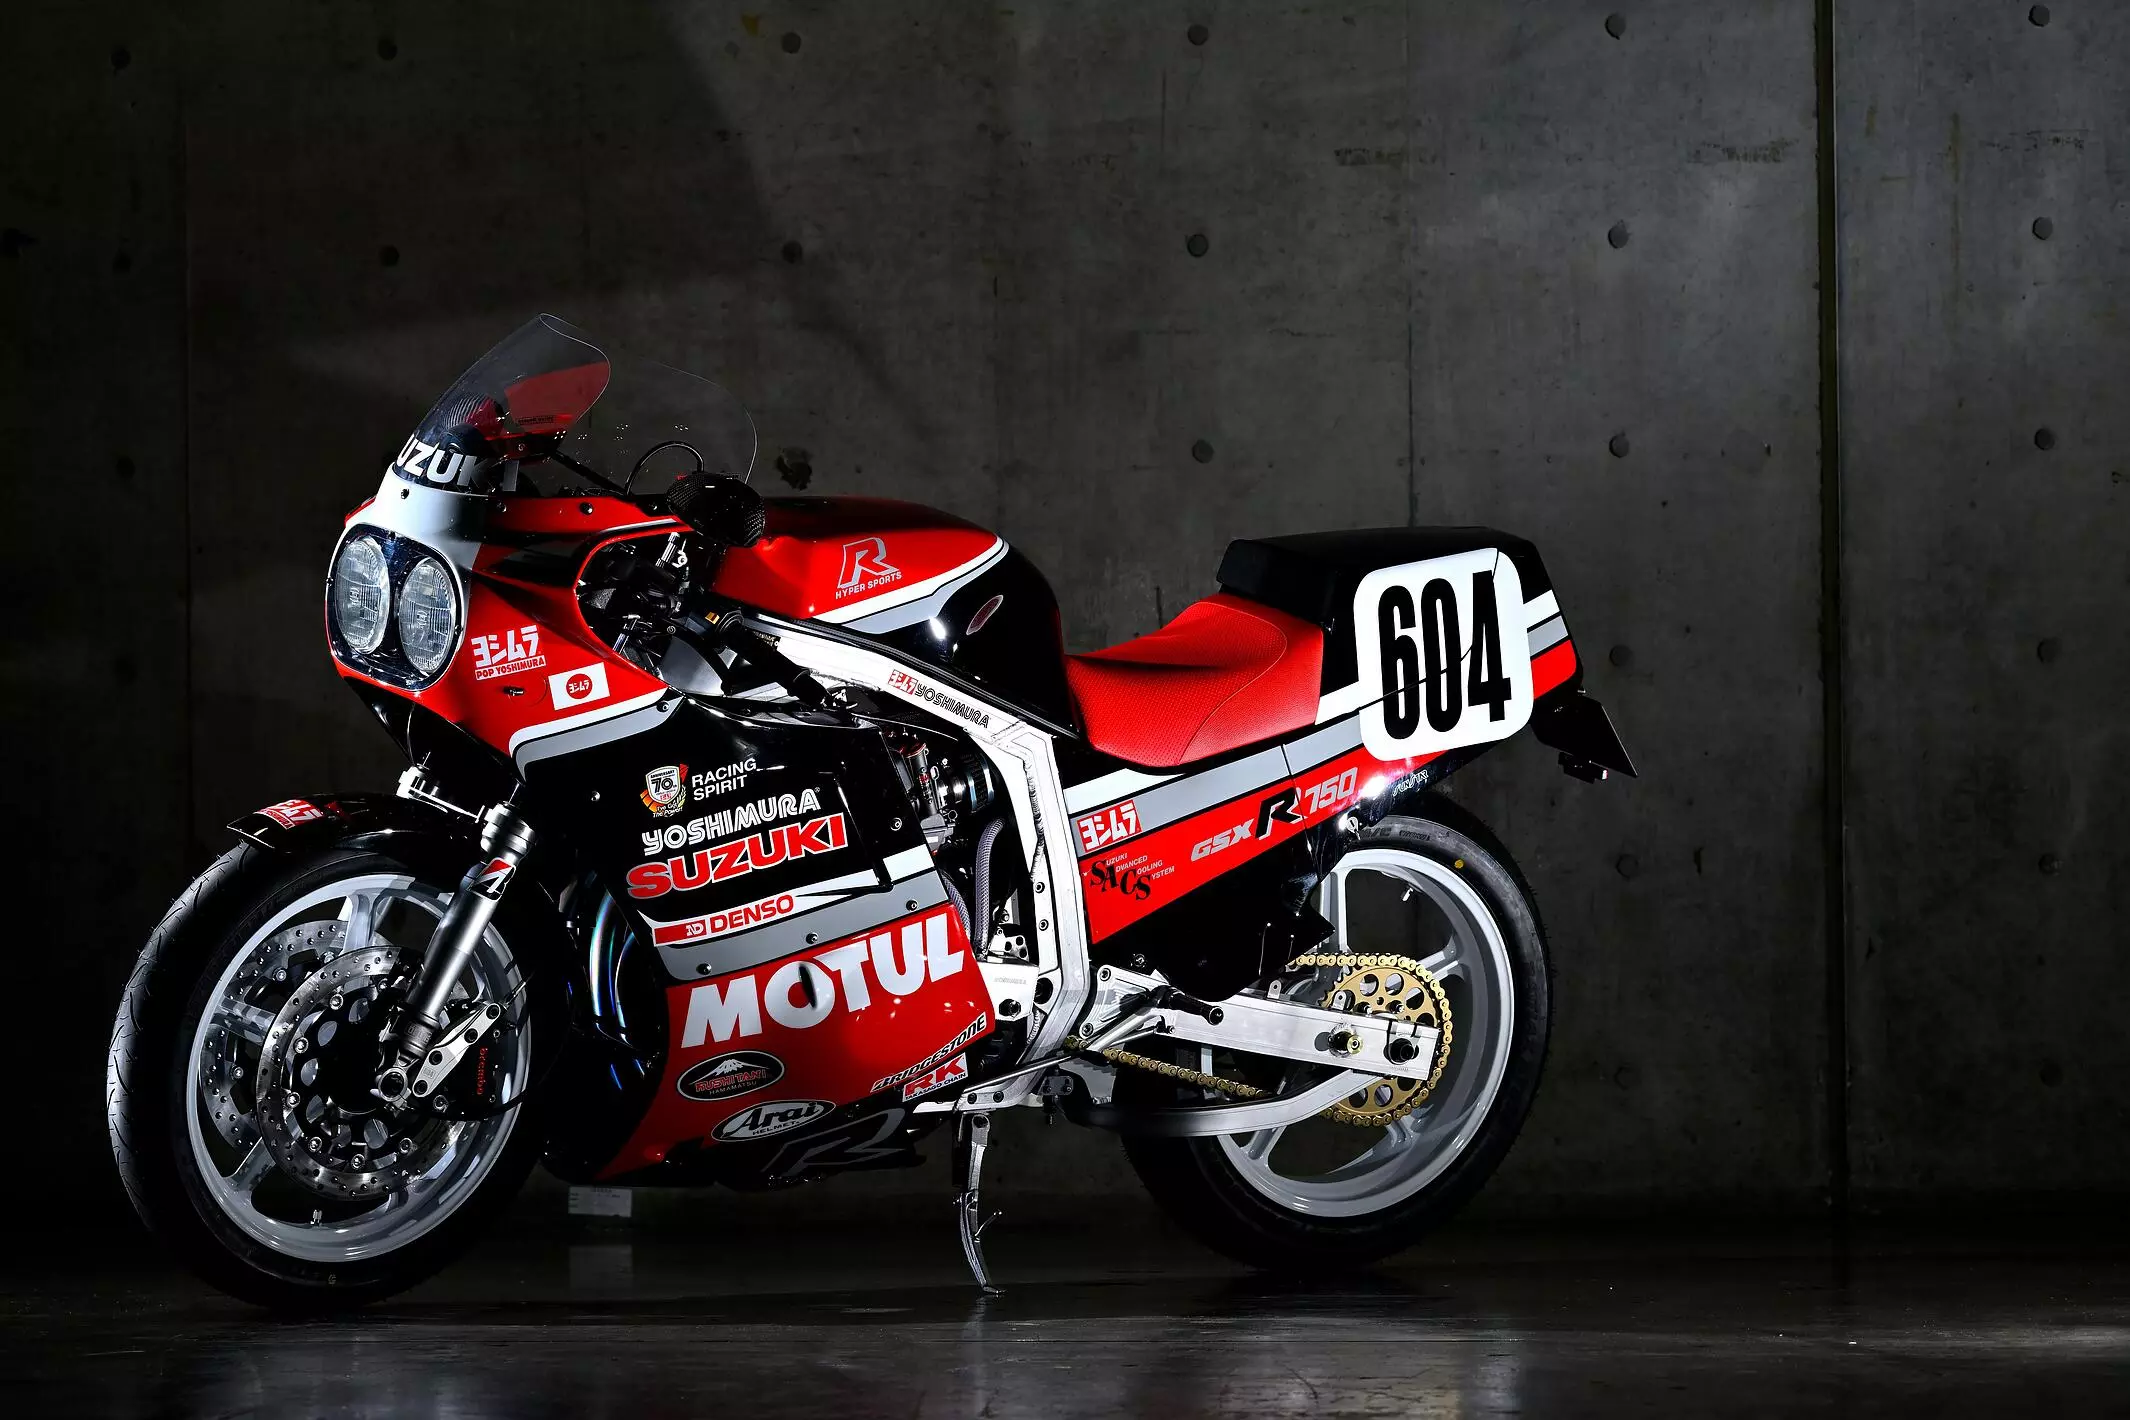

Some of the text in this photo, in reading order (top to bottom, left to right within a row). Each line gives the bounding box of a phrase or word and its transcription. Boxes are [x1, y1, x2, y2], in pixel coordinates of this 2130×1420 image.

[835, 571, 903, 600] HYPER SPORTS
[471, 625, 540, 668] ヨシムラ
[476, 656, 545, 680] POP YOSHIMURA
[1378, 570, 1512, 740] 604
[568, 679, 590, 694] ヨシムラ
[914, 683, 990, 728] YOSHIMURA
[692, 758, 757, 788] RACING
[693, 774, 748, 801] SPIRIT
[642, 791, 821, 856] YOSHIMURA
[1079, 802, 1140, 851] ヨシムラ
[1190, 819, 1255, 862] GSX
[1307, 766, 1358, 815] 750
[627, 813, 848, 899] SUZUKI
[711, 894, 795, 934] DENSO
[681, 914, 965, 1048] MOTUL
[476, 1047, 488, 1095] brembo
[871, 1014, 986, 1092] BRIDGESTONE
[906, 1056, 966, 1096] RK
[906, 1073, 967, 1100] TAKASAGO CHAIN
[720, 1102, 818, 1138] Arai
